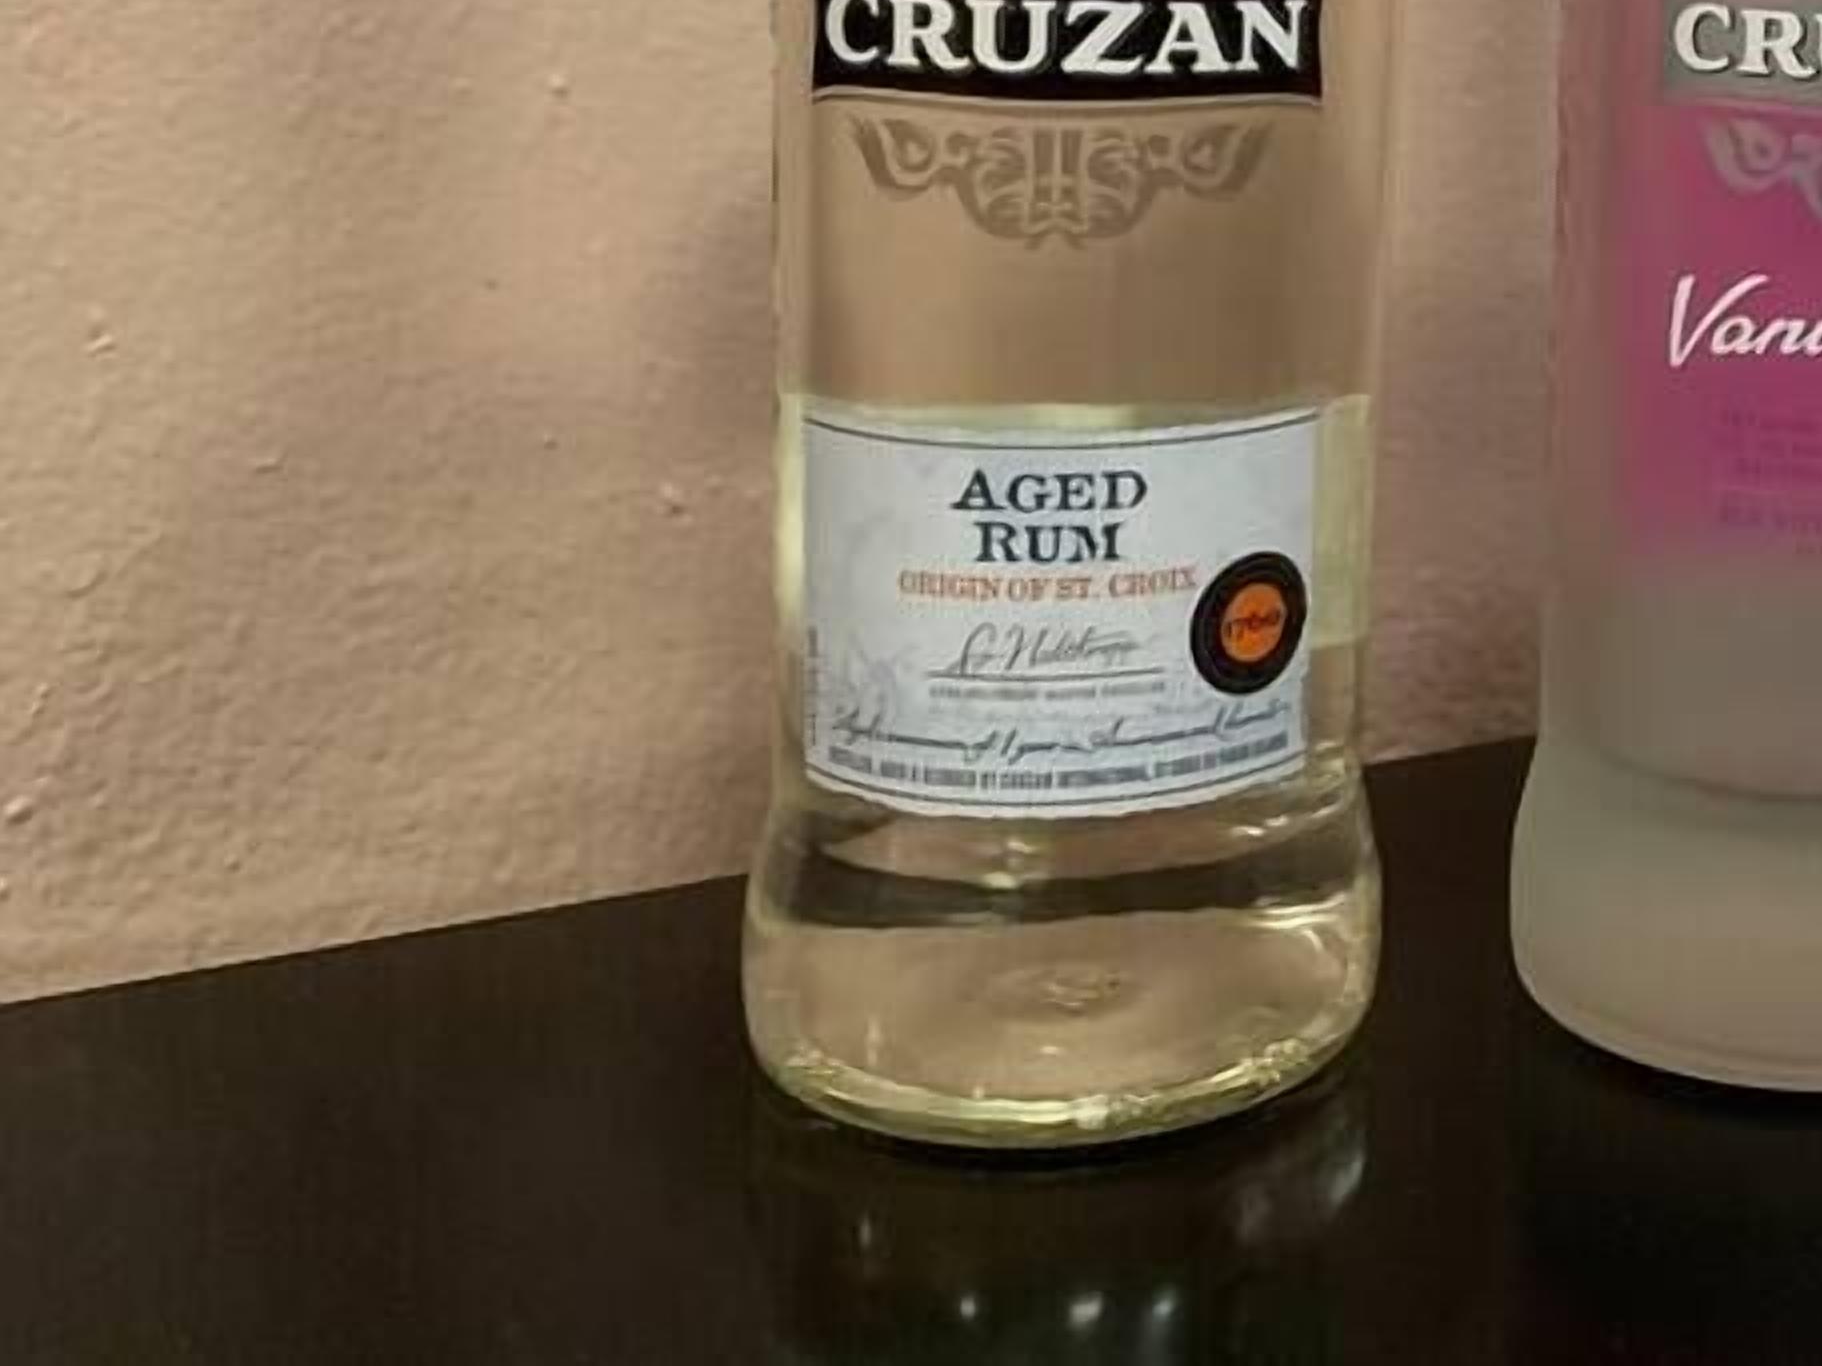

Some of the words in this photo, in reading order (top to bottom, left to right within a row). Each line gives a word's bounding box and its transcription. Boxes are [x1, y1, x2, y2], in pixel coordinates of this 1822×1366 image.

[950, 468, 1149, 514] AGED
[974, 520, 1124, 563] RUM
[899, 571, 999, 602] ORIGIN
[1006, 579, 1050, 602] OF
[1108, 566, 1199, 598] CROIX
